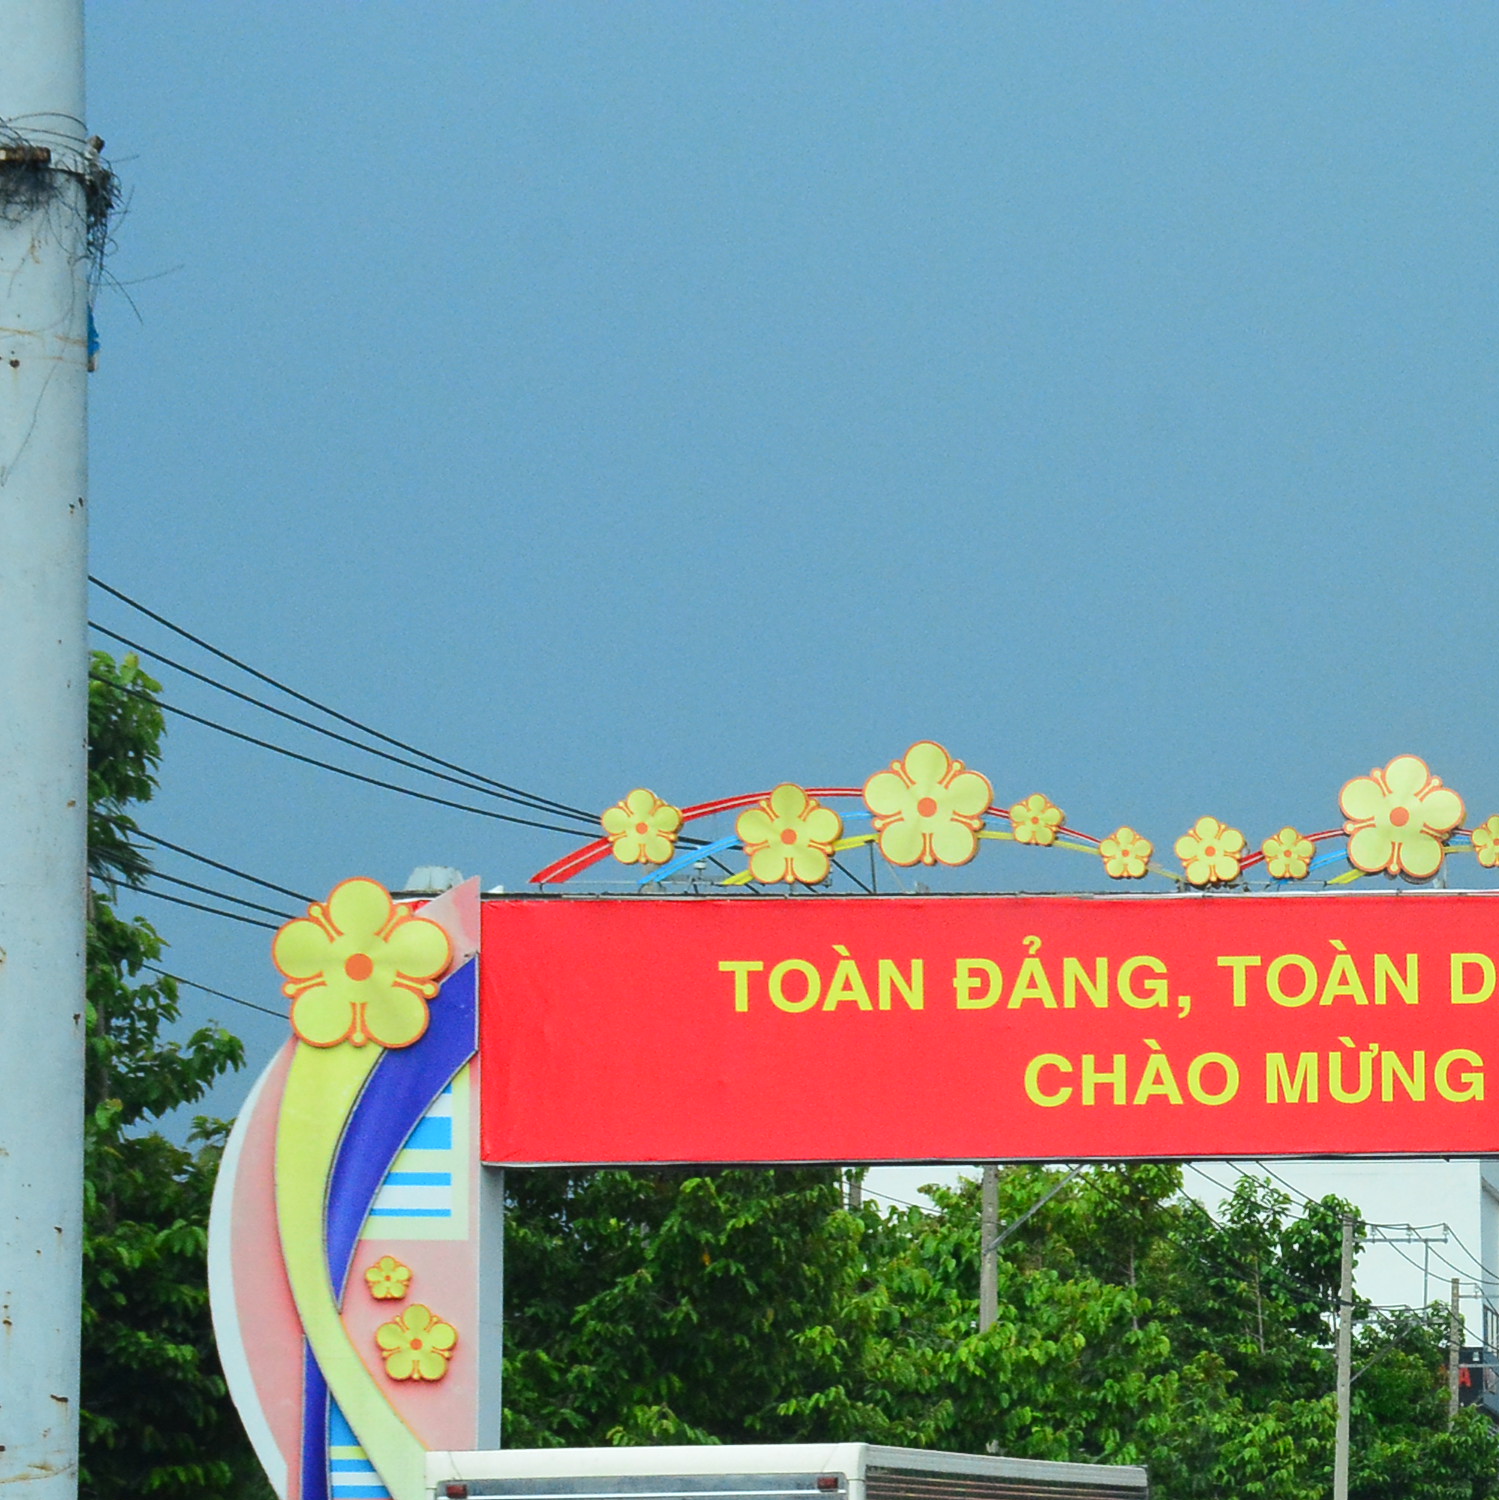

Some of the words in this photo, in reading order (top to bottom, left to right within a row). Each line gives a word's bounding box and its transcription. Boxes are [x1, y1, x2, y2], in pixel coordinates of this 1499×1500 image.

[719, 945, 924, 1012] TOÀN
[953, 936, 1191, 1018] ĐẢNG,
[1217, 940, 1418, 1007] TOÀN
[1025, 1039, 1239, 1107] CHÀO
[1266, 1037, 1484, 1103] MỪNG
